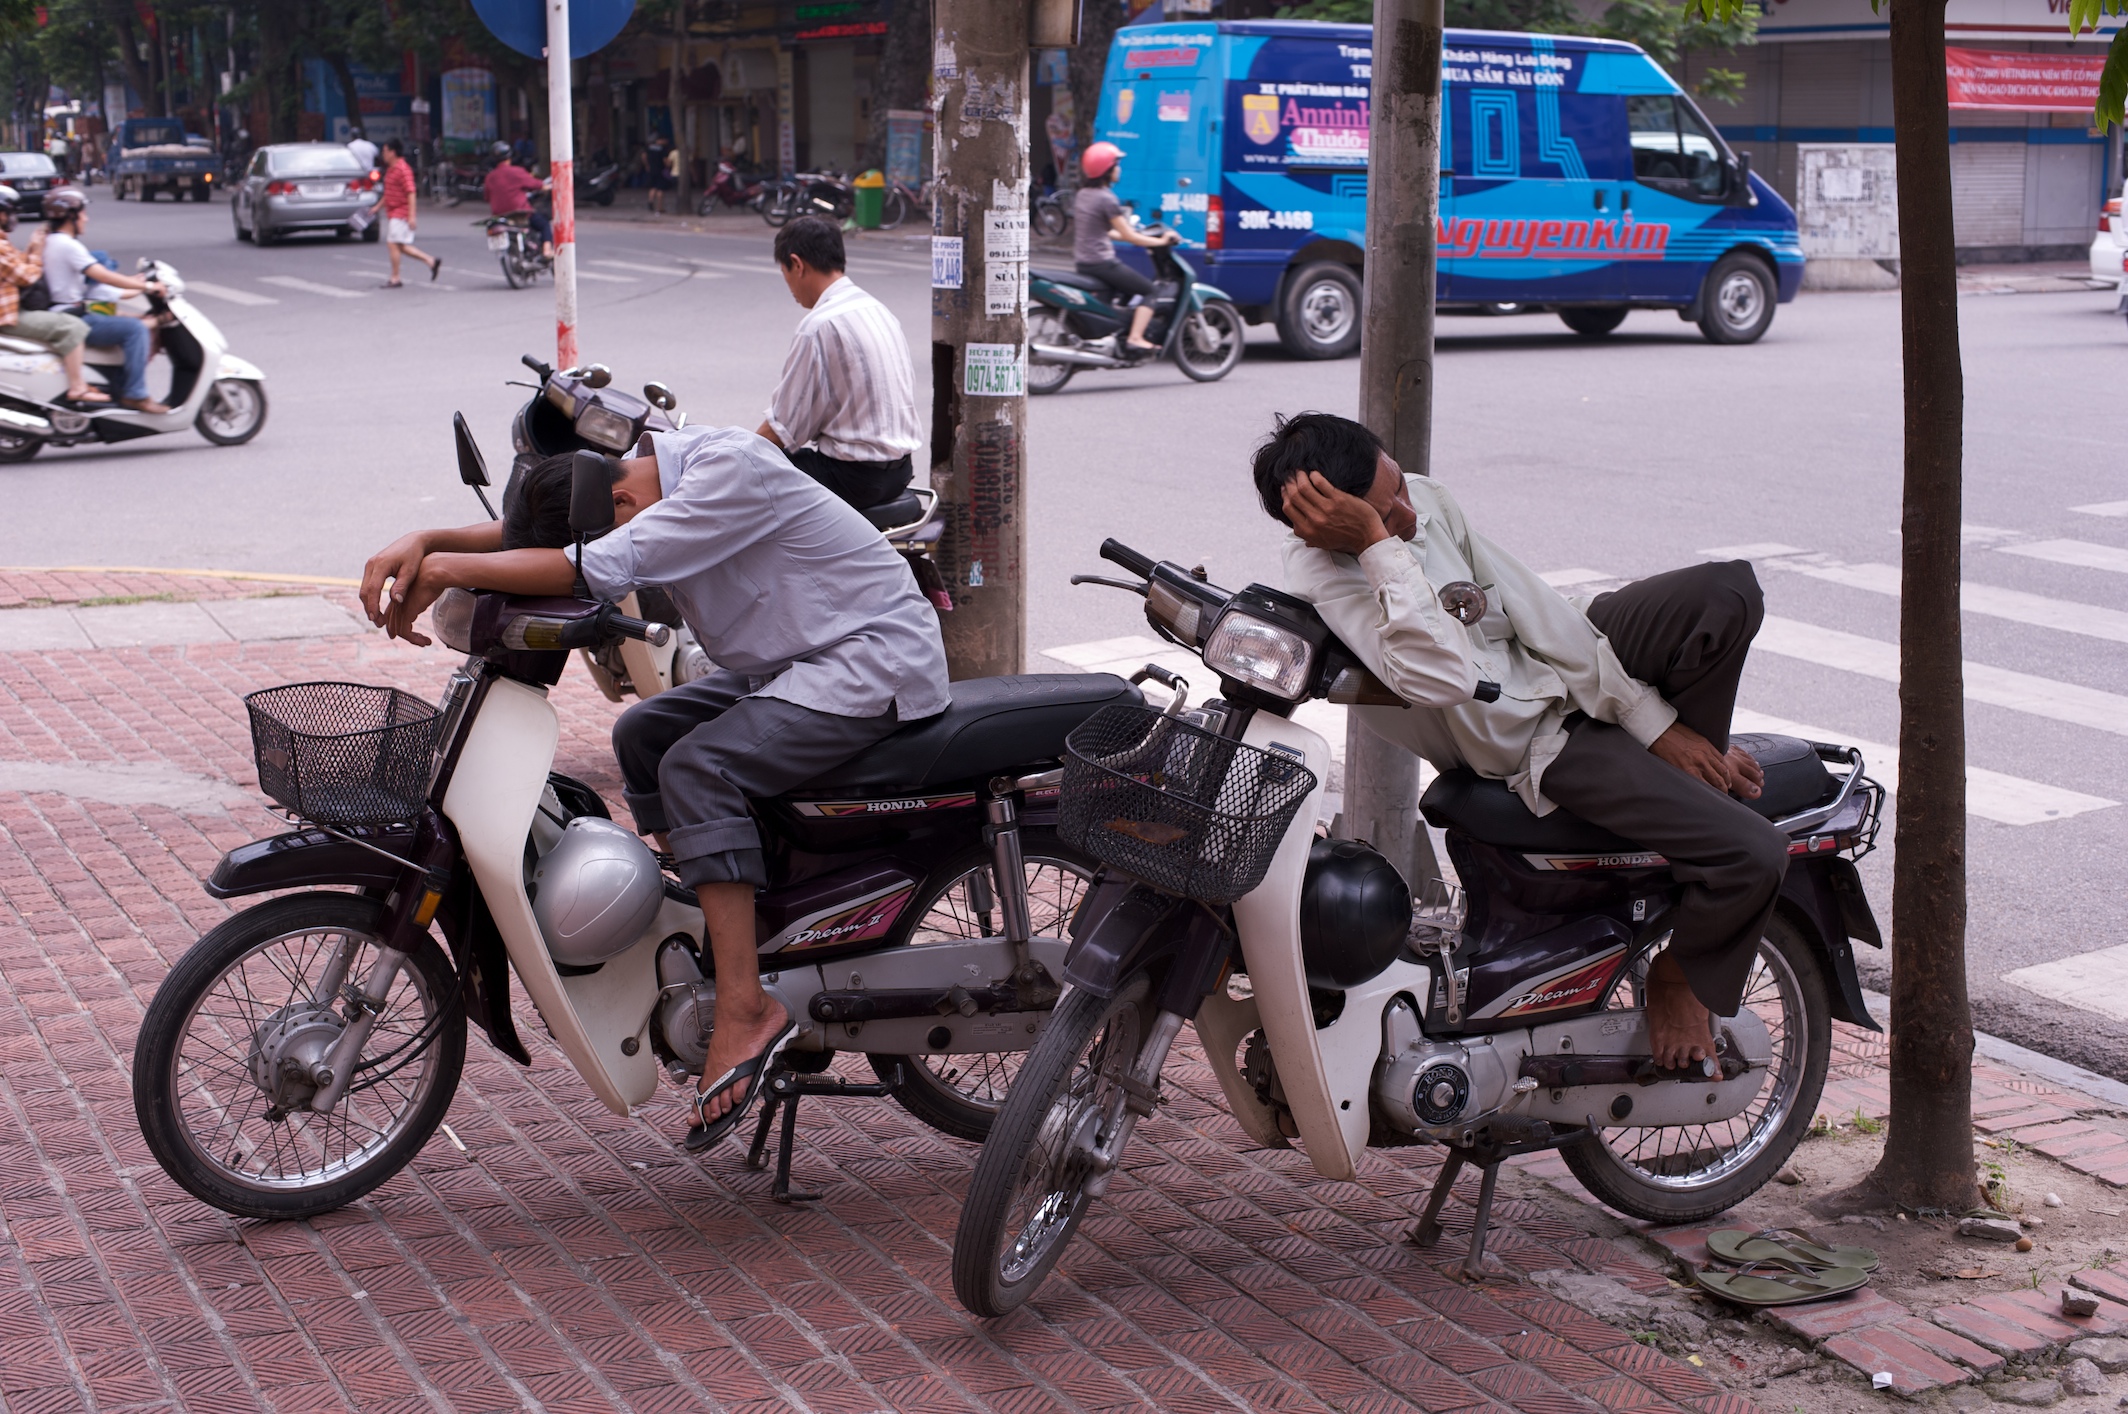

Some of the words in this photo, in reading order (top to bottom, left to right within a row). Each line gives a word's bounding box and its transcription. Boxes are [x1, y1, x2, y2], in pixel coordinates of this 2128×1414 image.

[1481, 51, 1513, 67] Hàng
[1507, 67, 1532, 85] SÀI
[1533, 69, 1564, 86] GÒN
[1259, 83, 1277, 94] XE
[1252, 111, 1272, 135] A
[1239, 210, 1313, 230] 30K-4468
[1437, 213, 1670, 260] NguyenKim
[969, 347, 990, 357] HÚT
[866, 799, 928, 812] HONDA
[1597, 855, 1653, 866] HONDA
[787, 921, 866, 946] Dream
[1509, 985, 1586, 1009] Dream
